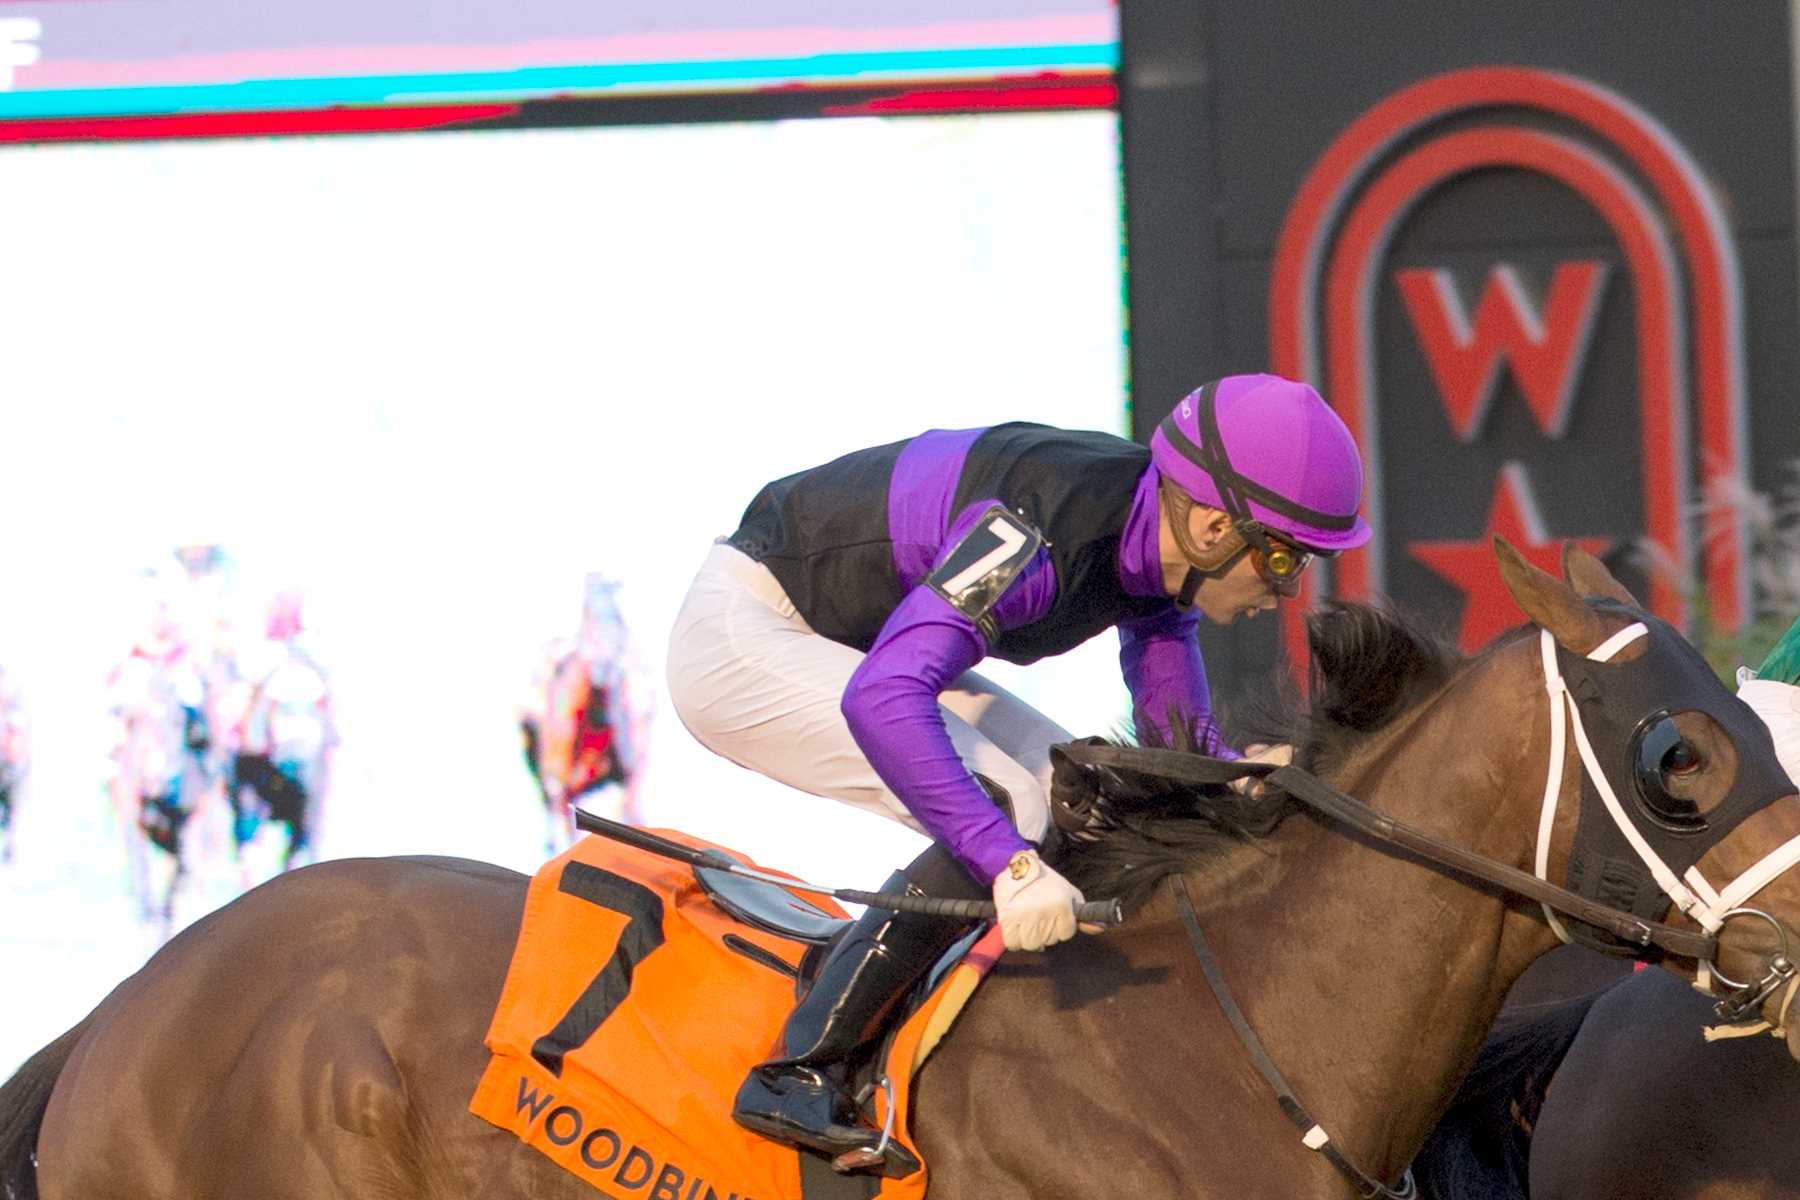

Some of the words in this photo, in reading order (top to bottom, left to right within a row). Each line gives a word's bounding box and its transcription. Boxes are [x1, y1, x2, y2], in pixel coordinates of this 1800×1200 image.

[1395, 262, 1605, 438] W
[941, 517, 1027, 595] 7
[531, 861, 665, 1078] 7
